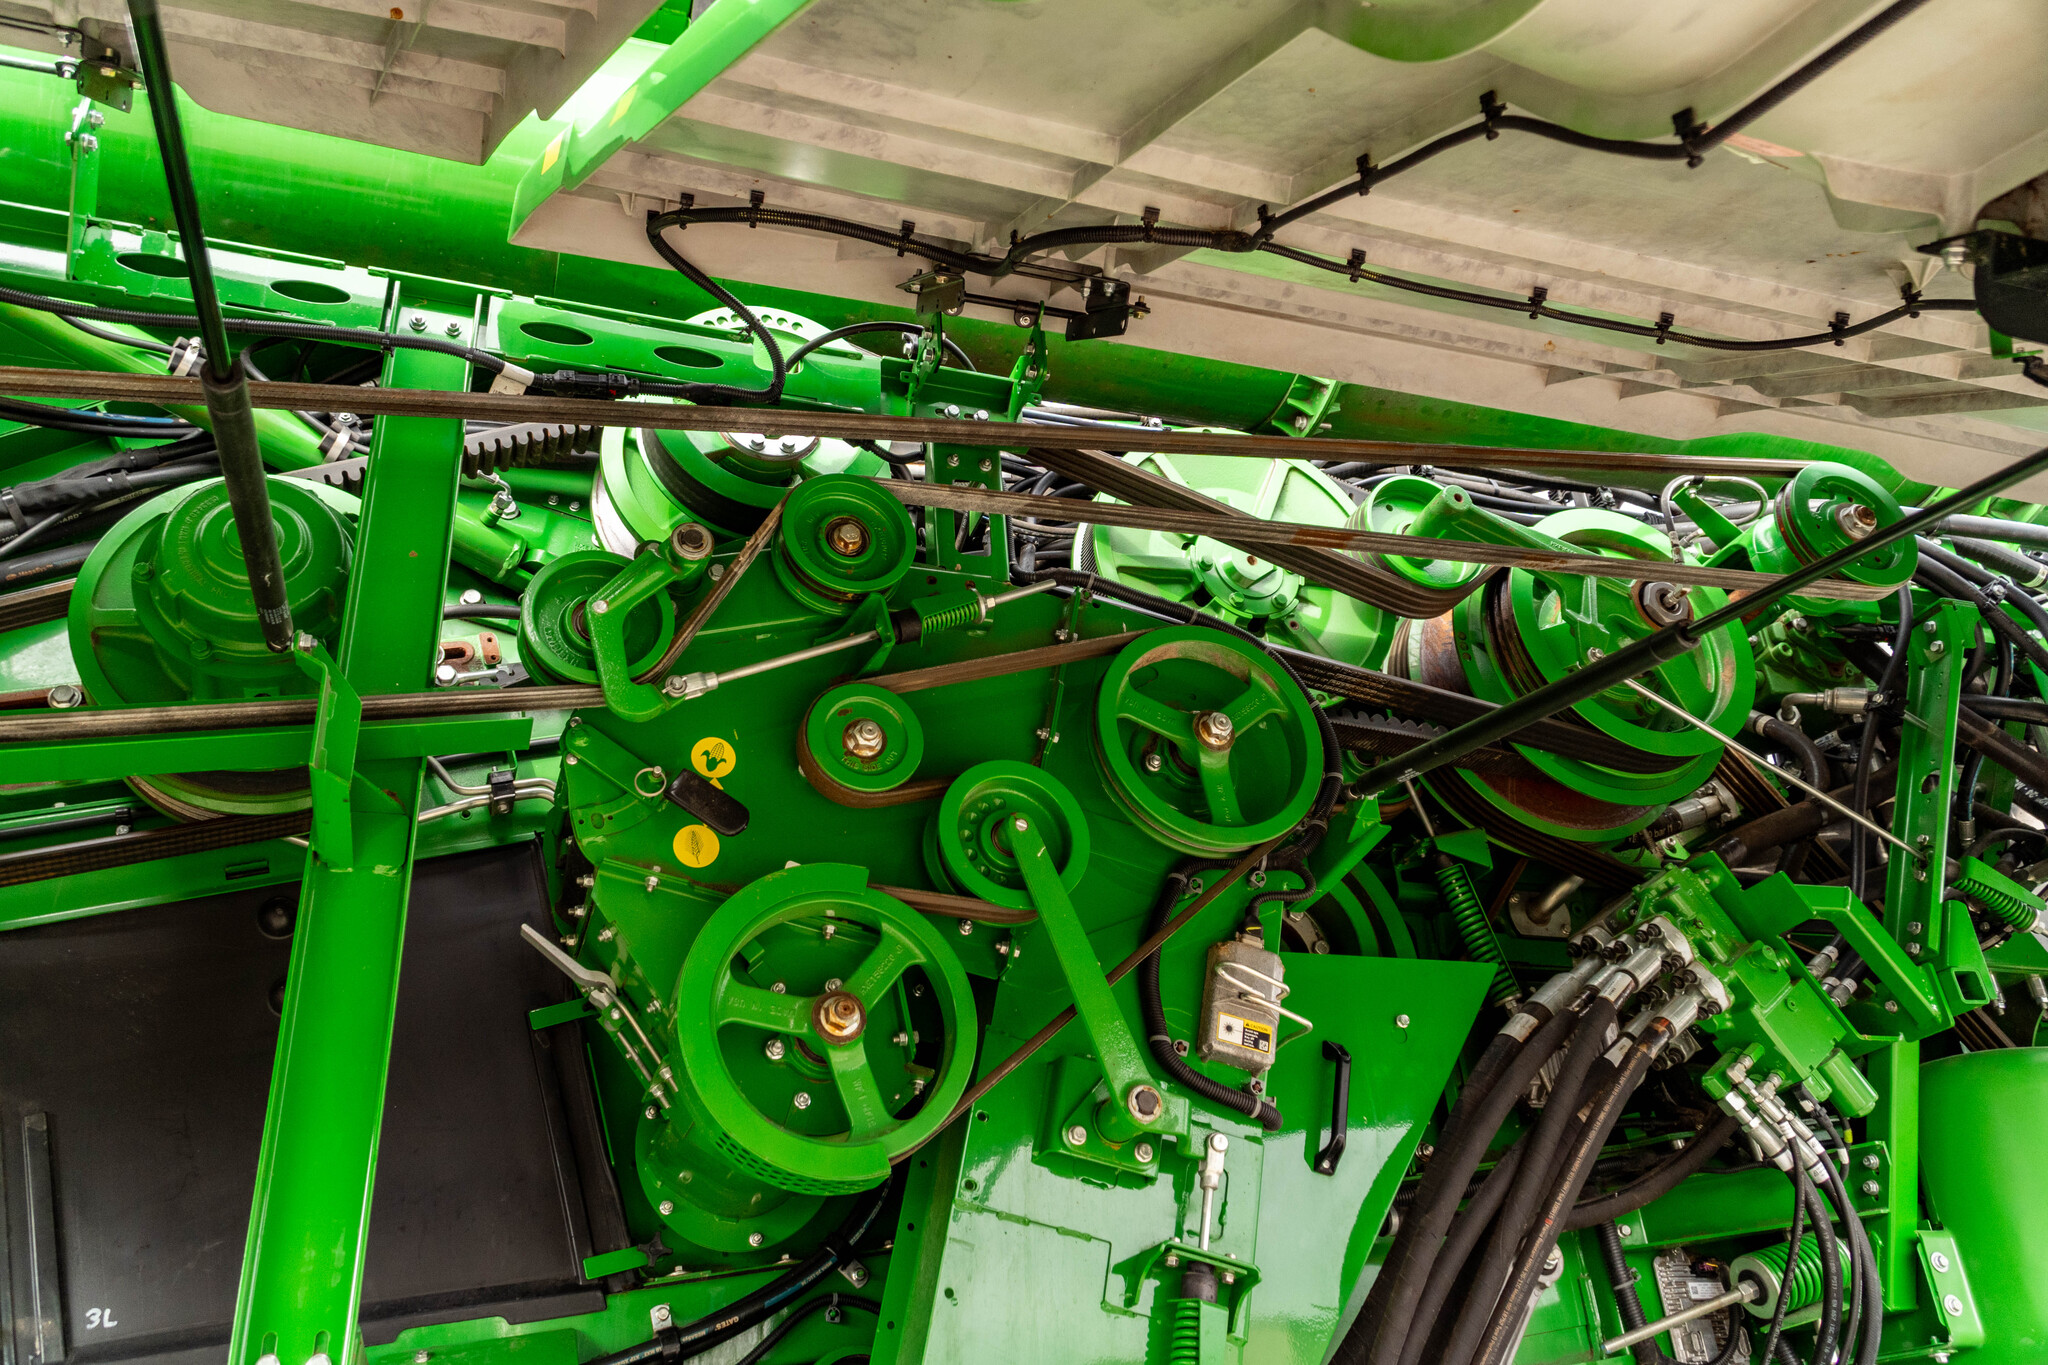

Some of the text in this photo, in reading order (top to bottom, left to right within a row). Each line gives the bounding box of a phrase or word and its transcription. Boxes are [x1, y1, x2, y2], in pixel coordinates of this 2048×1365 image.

[841, 751, 898, 772] THIS SIDE OUT
[1250, 1024, 1268, 1032] CAUTION
[1528, 1237, 1543, 1259] Resistant
[1522, 1257, 1533, 1271] MSHA
[1508, 1287, 1519, 1302] Meets
[1831, 1299, 1837, 1307] EN
[85, 1307, 118, 1330] 3L
[713, 1315, 740, 1330] GATES
